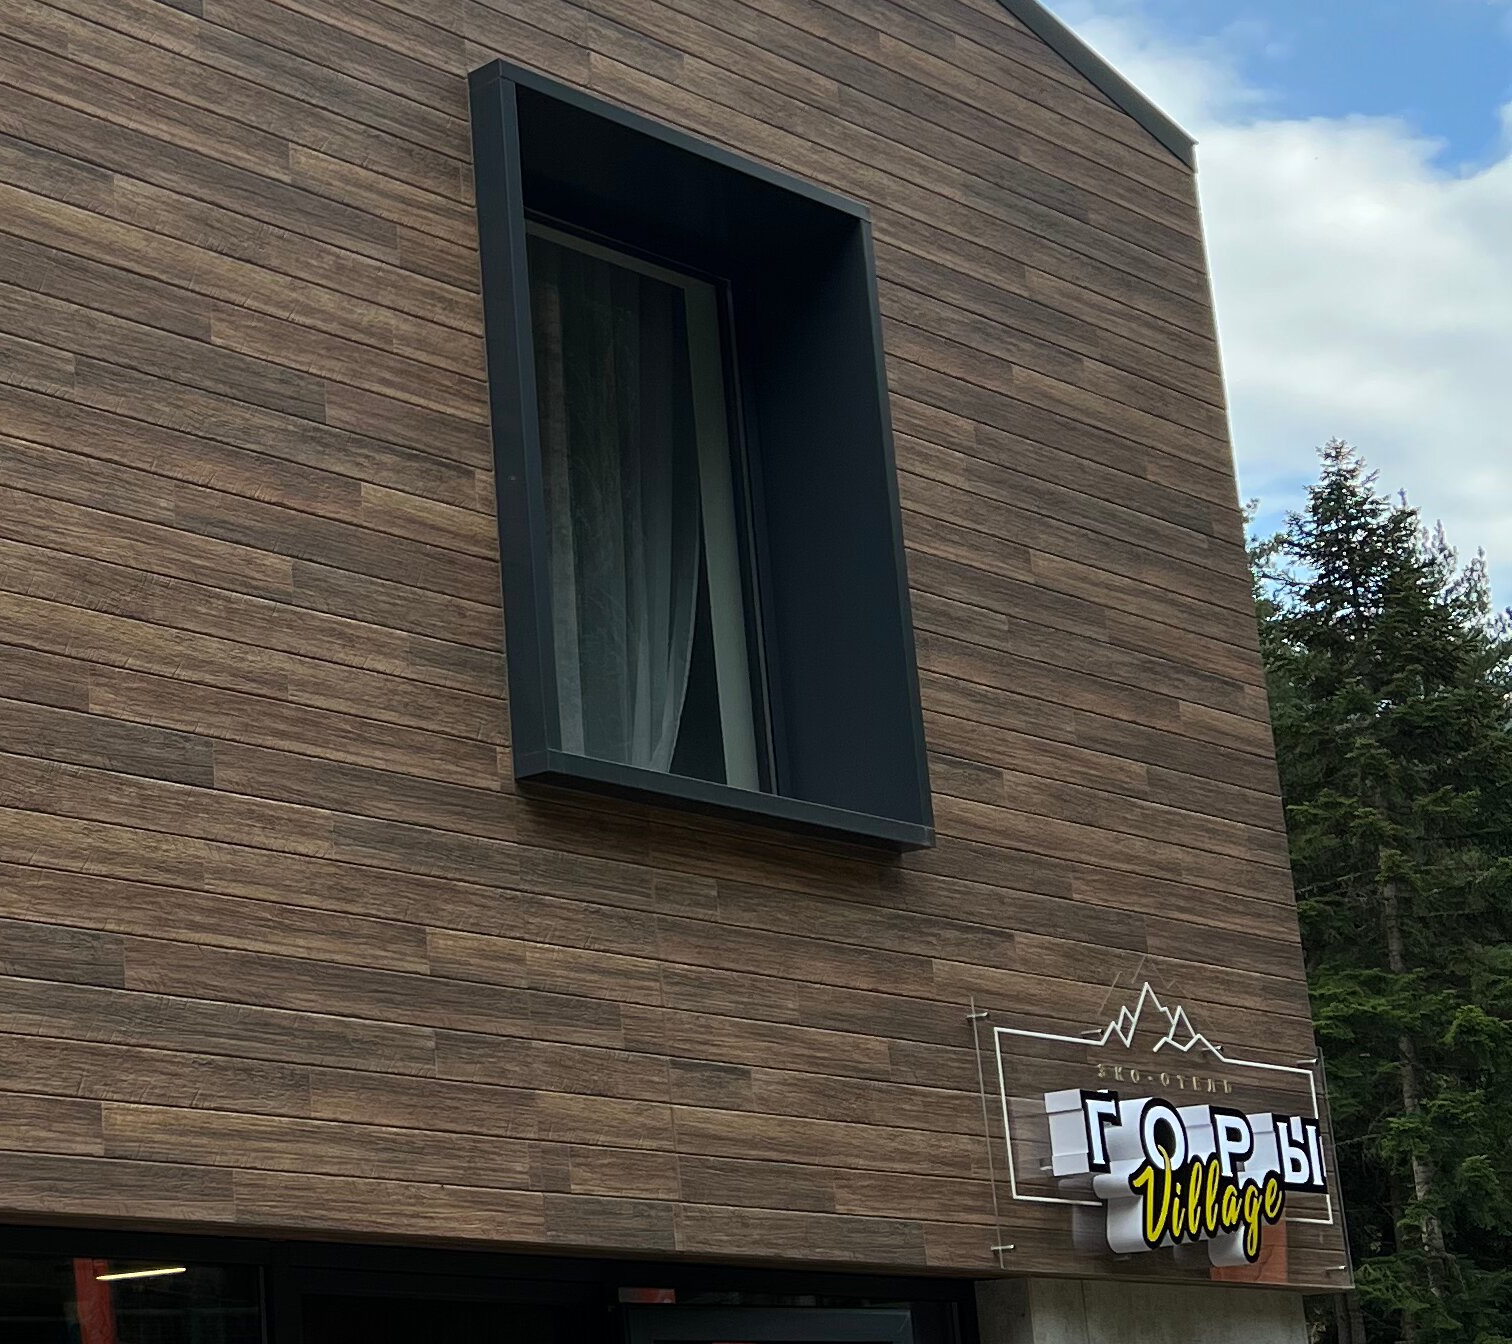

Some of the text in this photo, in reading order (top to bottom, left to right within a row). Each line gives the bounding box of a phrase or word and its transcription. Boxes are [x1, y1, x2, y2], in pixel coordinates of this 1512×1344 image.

[1097, 1063, 1233, 1094] ЭКО-ОТЕЛЬ
[1084, 1096, 1326, 1187] ГОРЫ
[1132, 1144, 1283, 1257] Village
